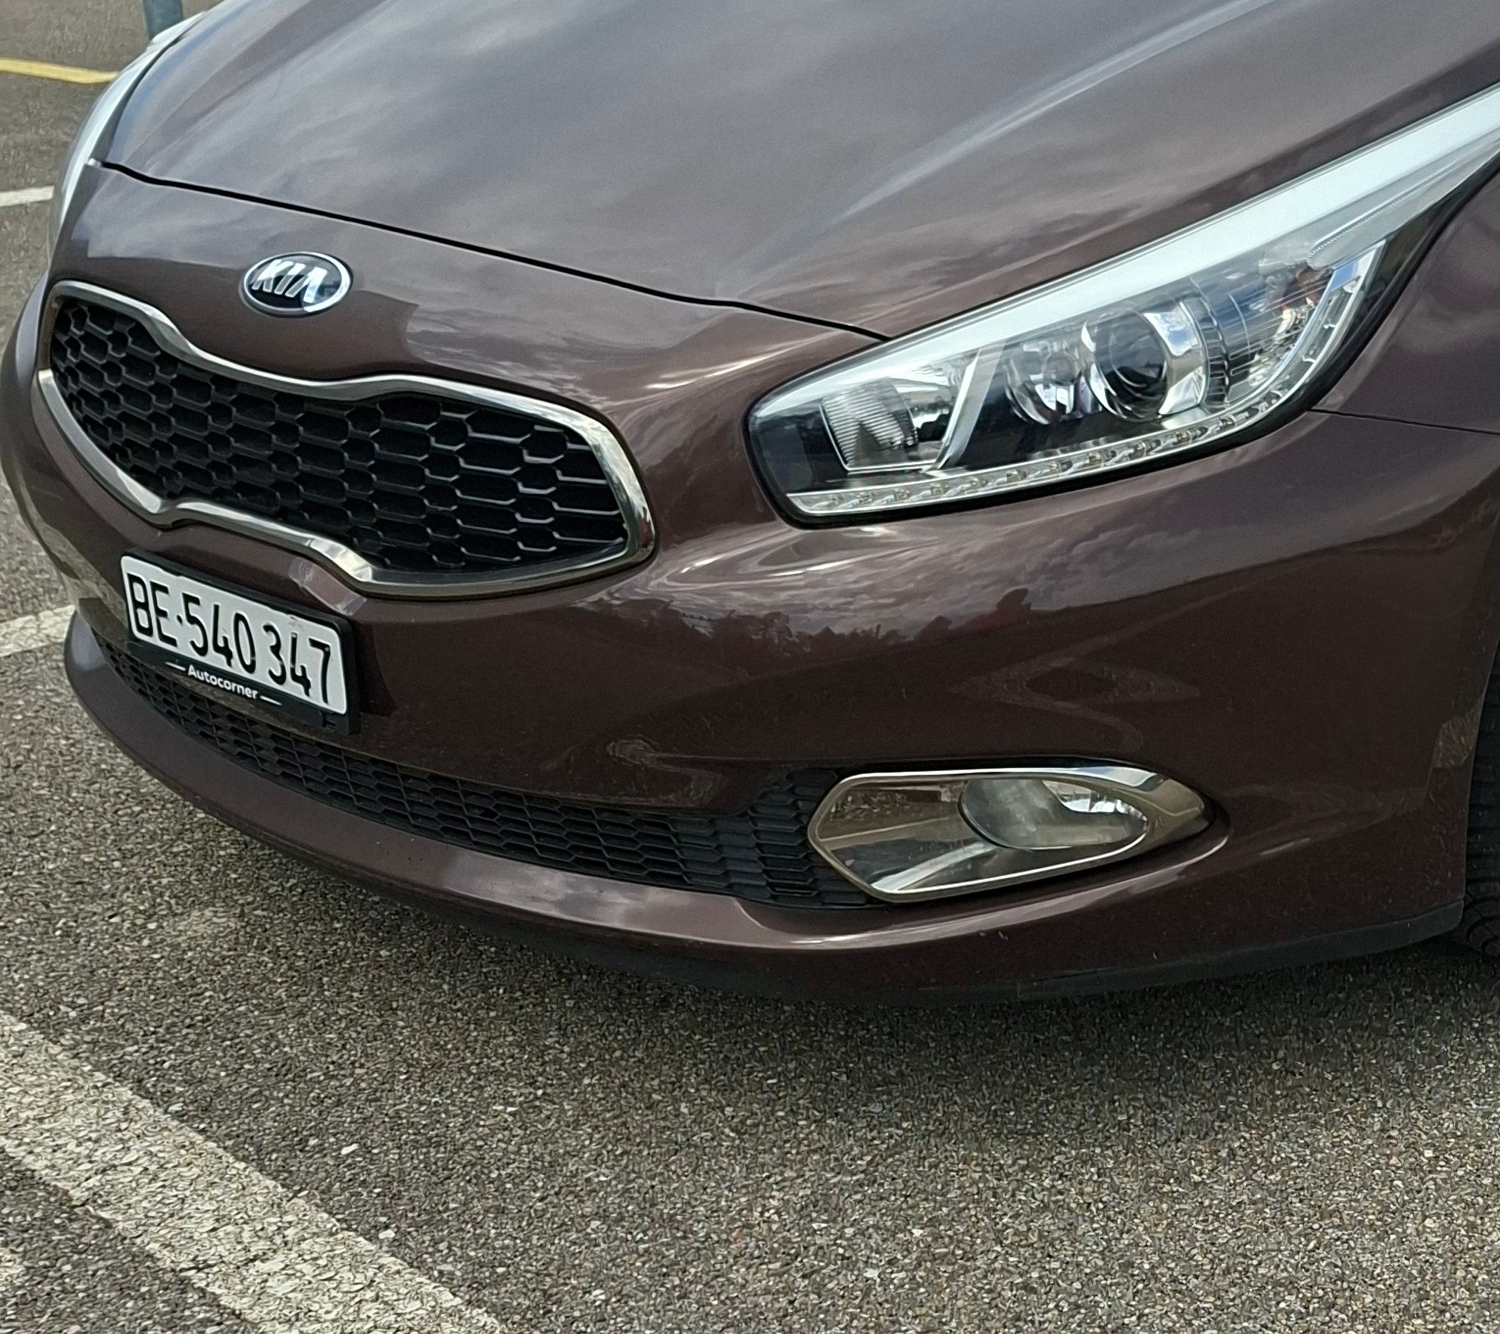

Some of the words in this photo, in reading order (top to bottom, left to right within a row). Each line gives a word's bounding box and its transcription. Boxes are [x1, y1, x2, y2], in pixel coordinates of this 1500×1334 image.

[250, 259, 328, 304] KIA
[188, 664, 259, 701] Autocorner
[263, 624, 332, 705] 347
